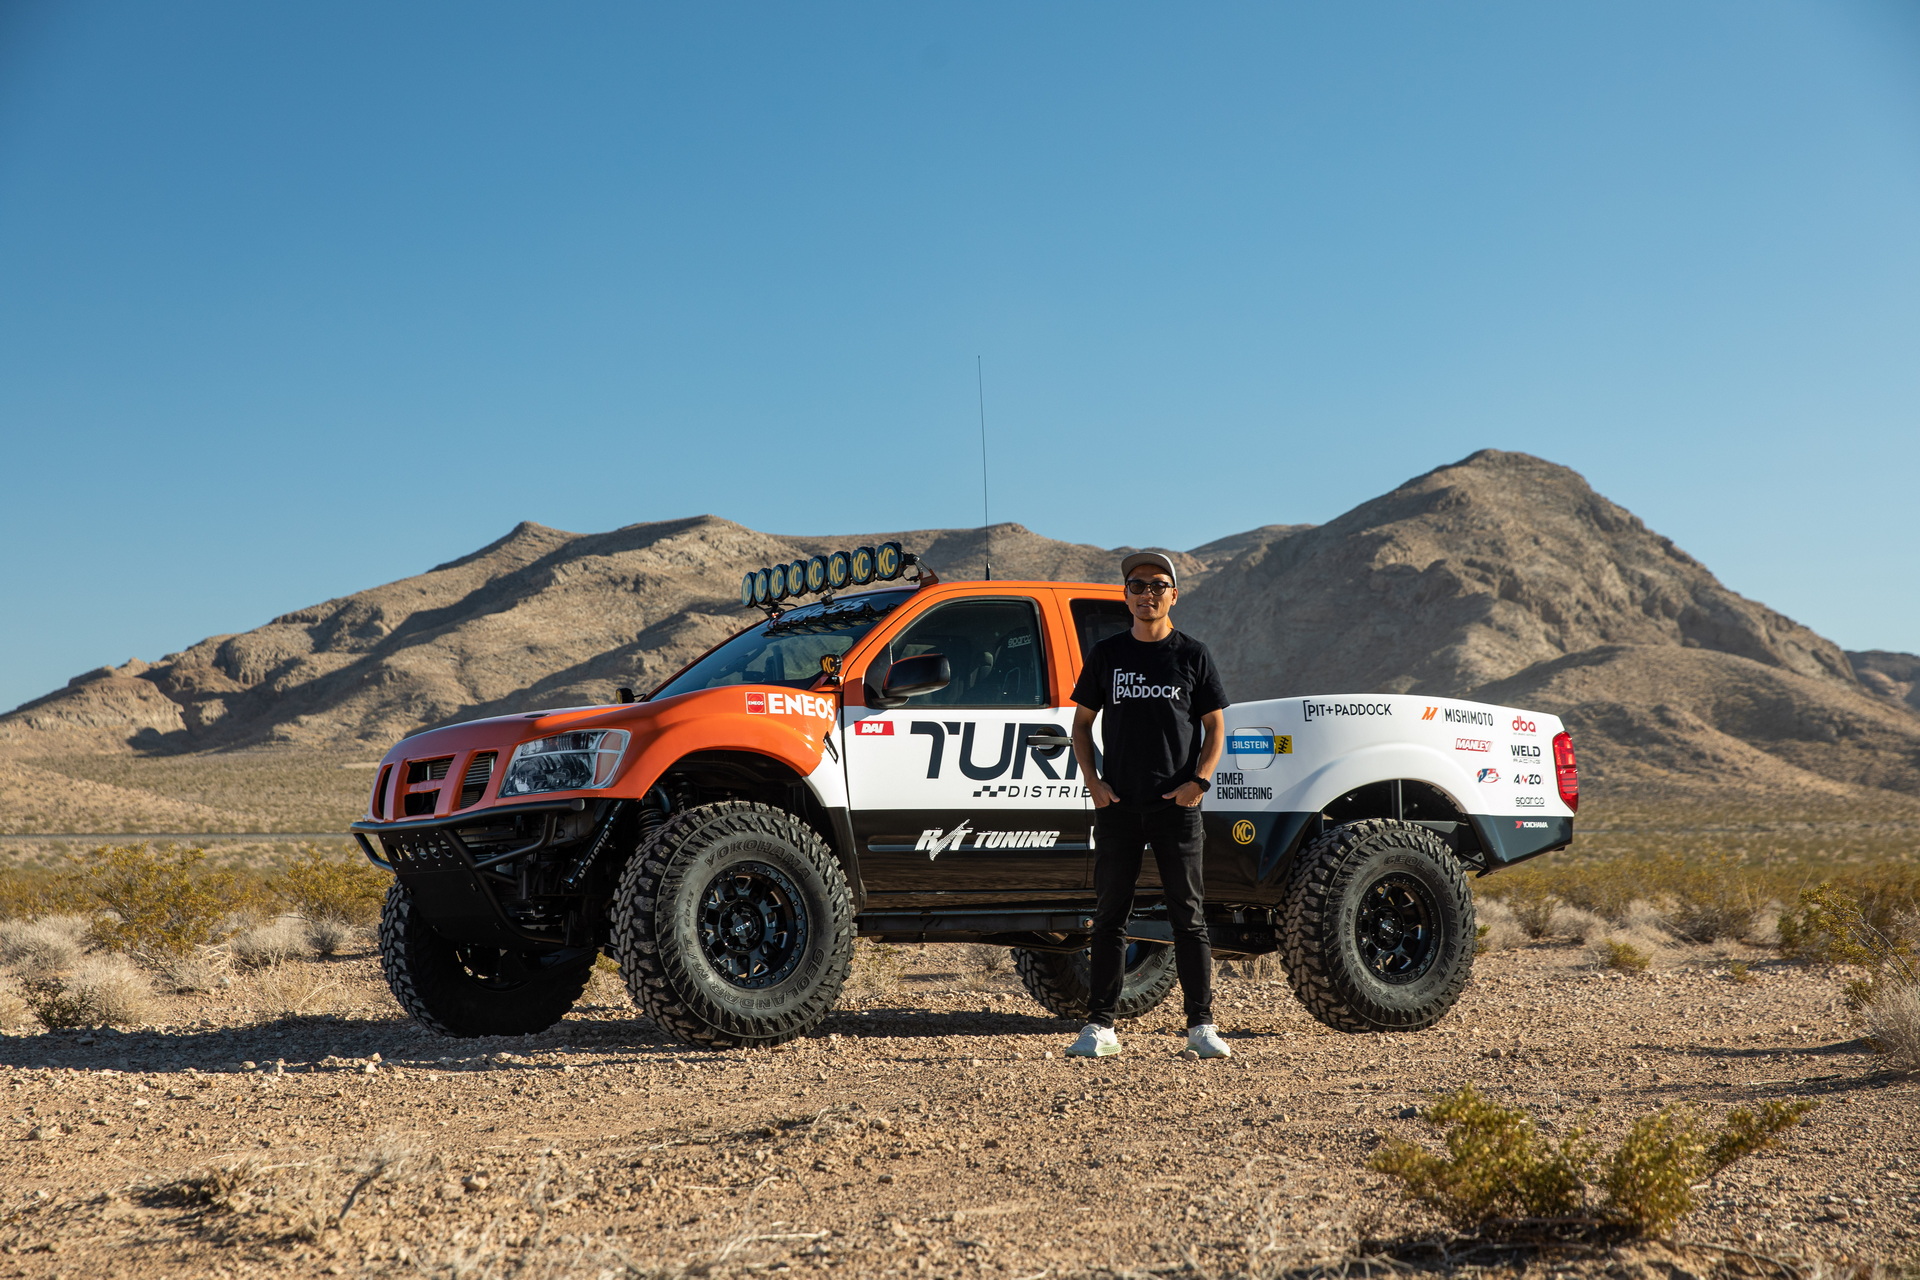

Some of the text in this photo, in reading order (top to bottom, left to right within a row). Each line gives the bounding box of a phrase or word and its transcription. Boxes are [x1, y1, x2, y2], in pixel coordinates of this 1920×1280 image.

[829, 557, 844, 584] KC
[853, 552, 868, 580] KC
[878, 547, 895, 576] KC
[788, 565, 801, 592] KC
[808, 561, 822, 588] KC
[755, 577, 765, 600] KC
[771, 573, 783, 597] KC
[822, 657, 835, 673] KC
[1116, 672, 1146, 685] PIT+
[1116, 685, 1181, 701] PADDOCK
[768, 693, 835, 721] ENEOS
[1444, 708, 1494, 726] MISHIMOTO
[1512, 715, 1537, 733] dba
[861, 723, 884, 734] DAI
[1231, 741, 1269, 749] BILSTEIN
[1455, 738, 1492, 752] MANLEY
[1511, 745, 1541, 757] WELD
[1216, 772, 1244, 786] EIMER
[1513, 774, 1542, 785] ANZO
[1217, 787, 1273, 800] ENGINEERING
[1515, 796, 1545, 807] sparco
[1236, 822, 1252, 842] KC
[1522, 821, 1549, 829] YOKOHAMA
[973, 830, 1060, 848] TUNING
[704, 839, 812, 881] YOKOHAMA
[682, 933, 710, 980] M/T
[709, 948, 825, 1010] GEOLANDAR
